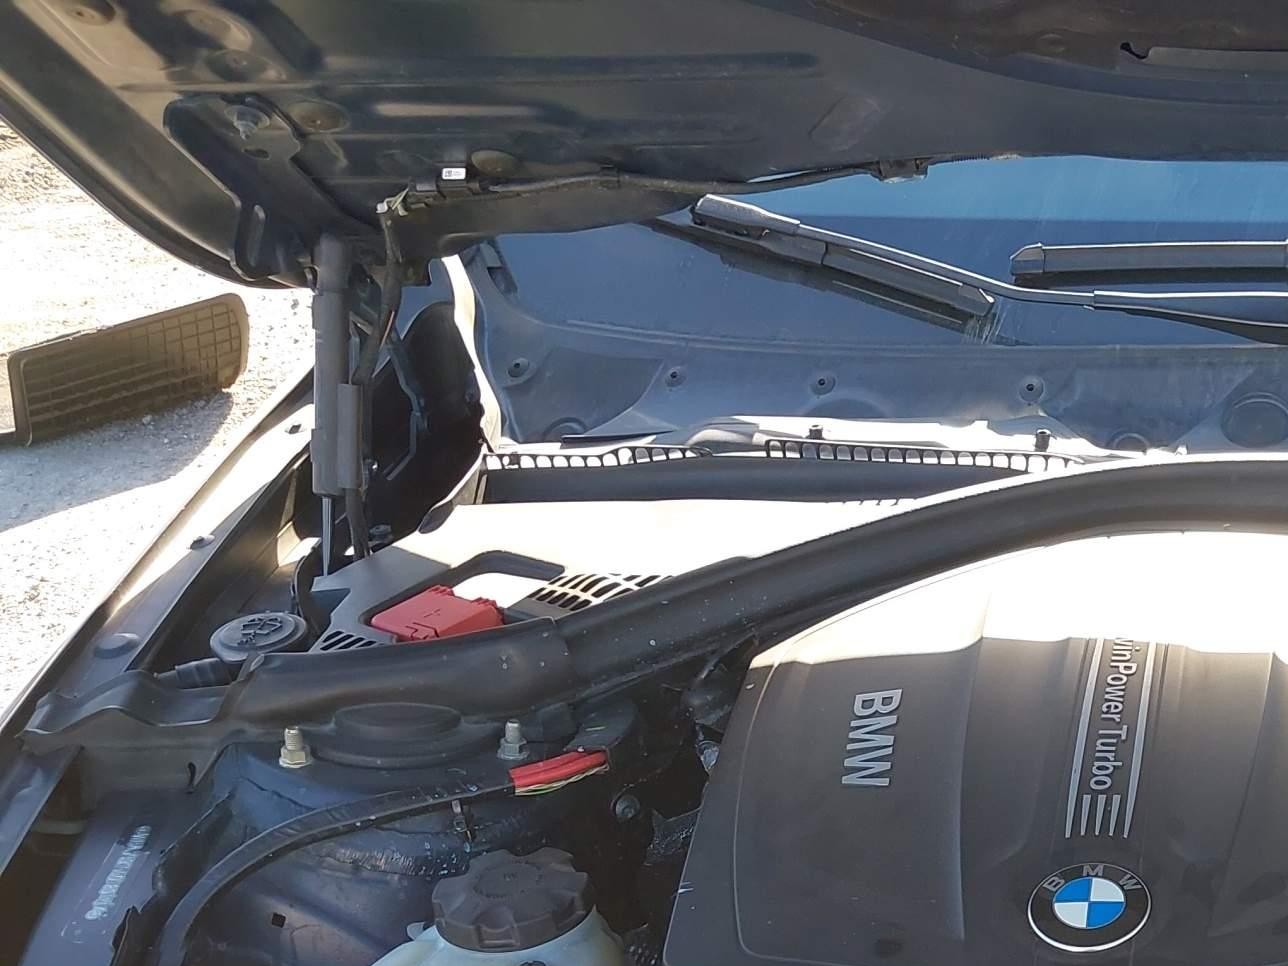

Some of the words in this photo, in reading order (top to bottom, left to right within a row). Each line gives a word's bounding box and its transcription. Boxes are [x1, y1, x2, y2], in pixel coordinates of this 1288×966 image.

[1100, 637, 1141, 722] winPower
[841, 687, 903, 787] BMW
[1089, 724, 1128, 791] Turbo
[1044, 863, 1143, 891] BMW
